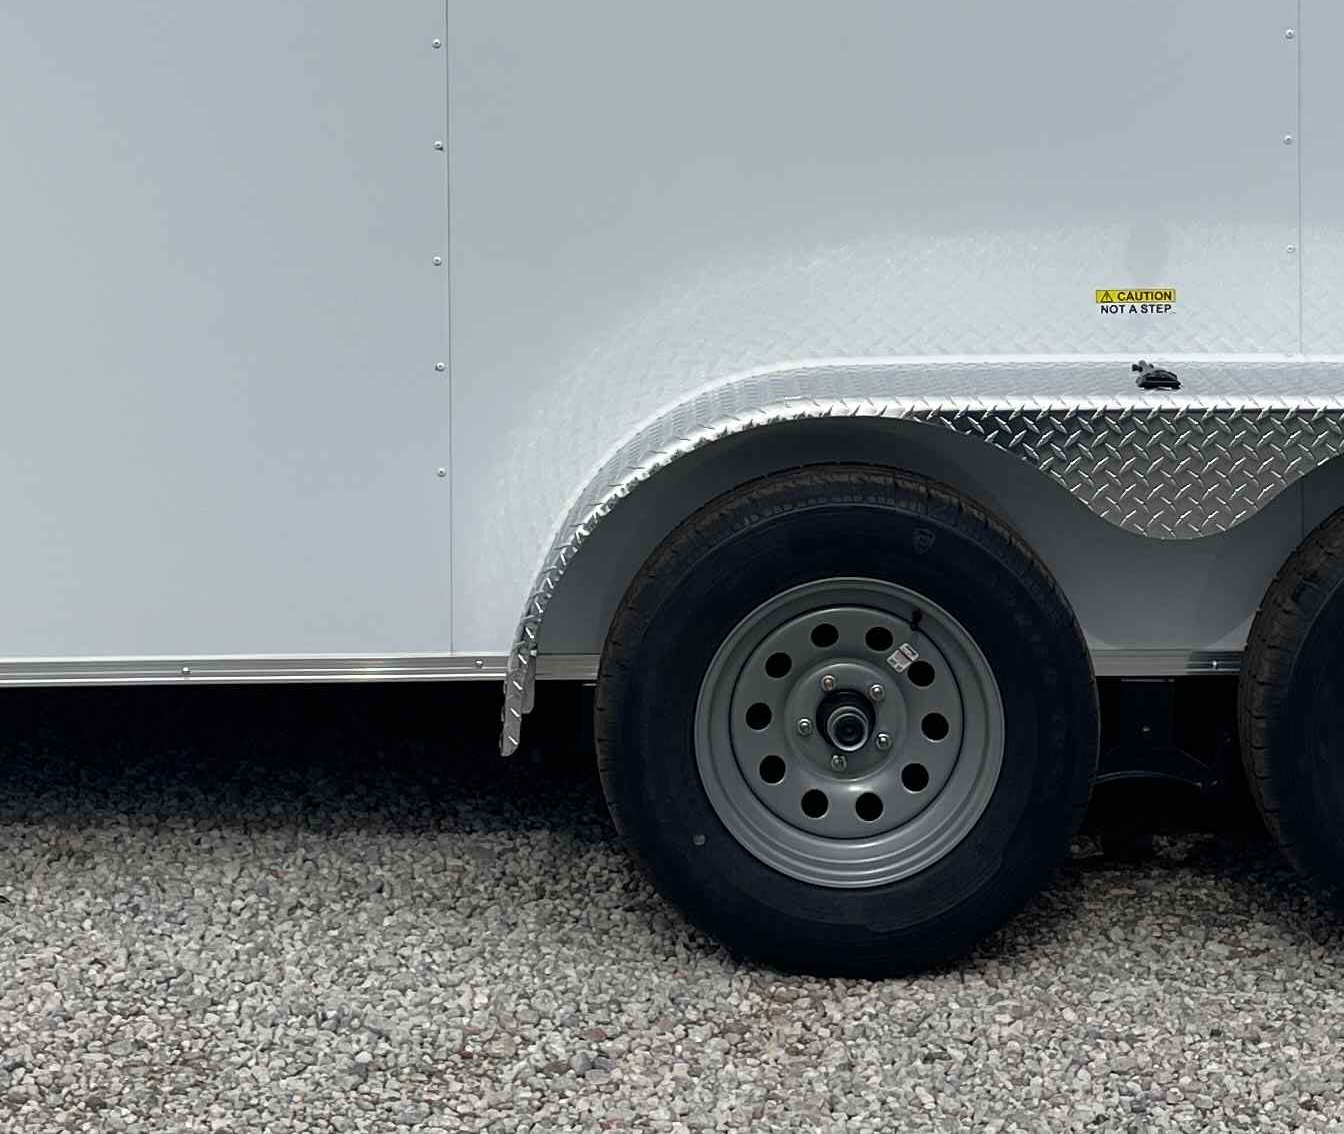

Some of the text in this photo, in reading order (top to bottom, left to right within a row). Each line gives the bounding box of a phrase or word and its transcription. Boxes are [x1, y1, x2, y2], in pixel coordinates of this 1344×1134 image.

[1116, 290, 1172, 302] CAUTION
[1100, 303, 1172, 314] NOT A STEP
